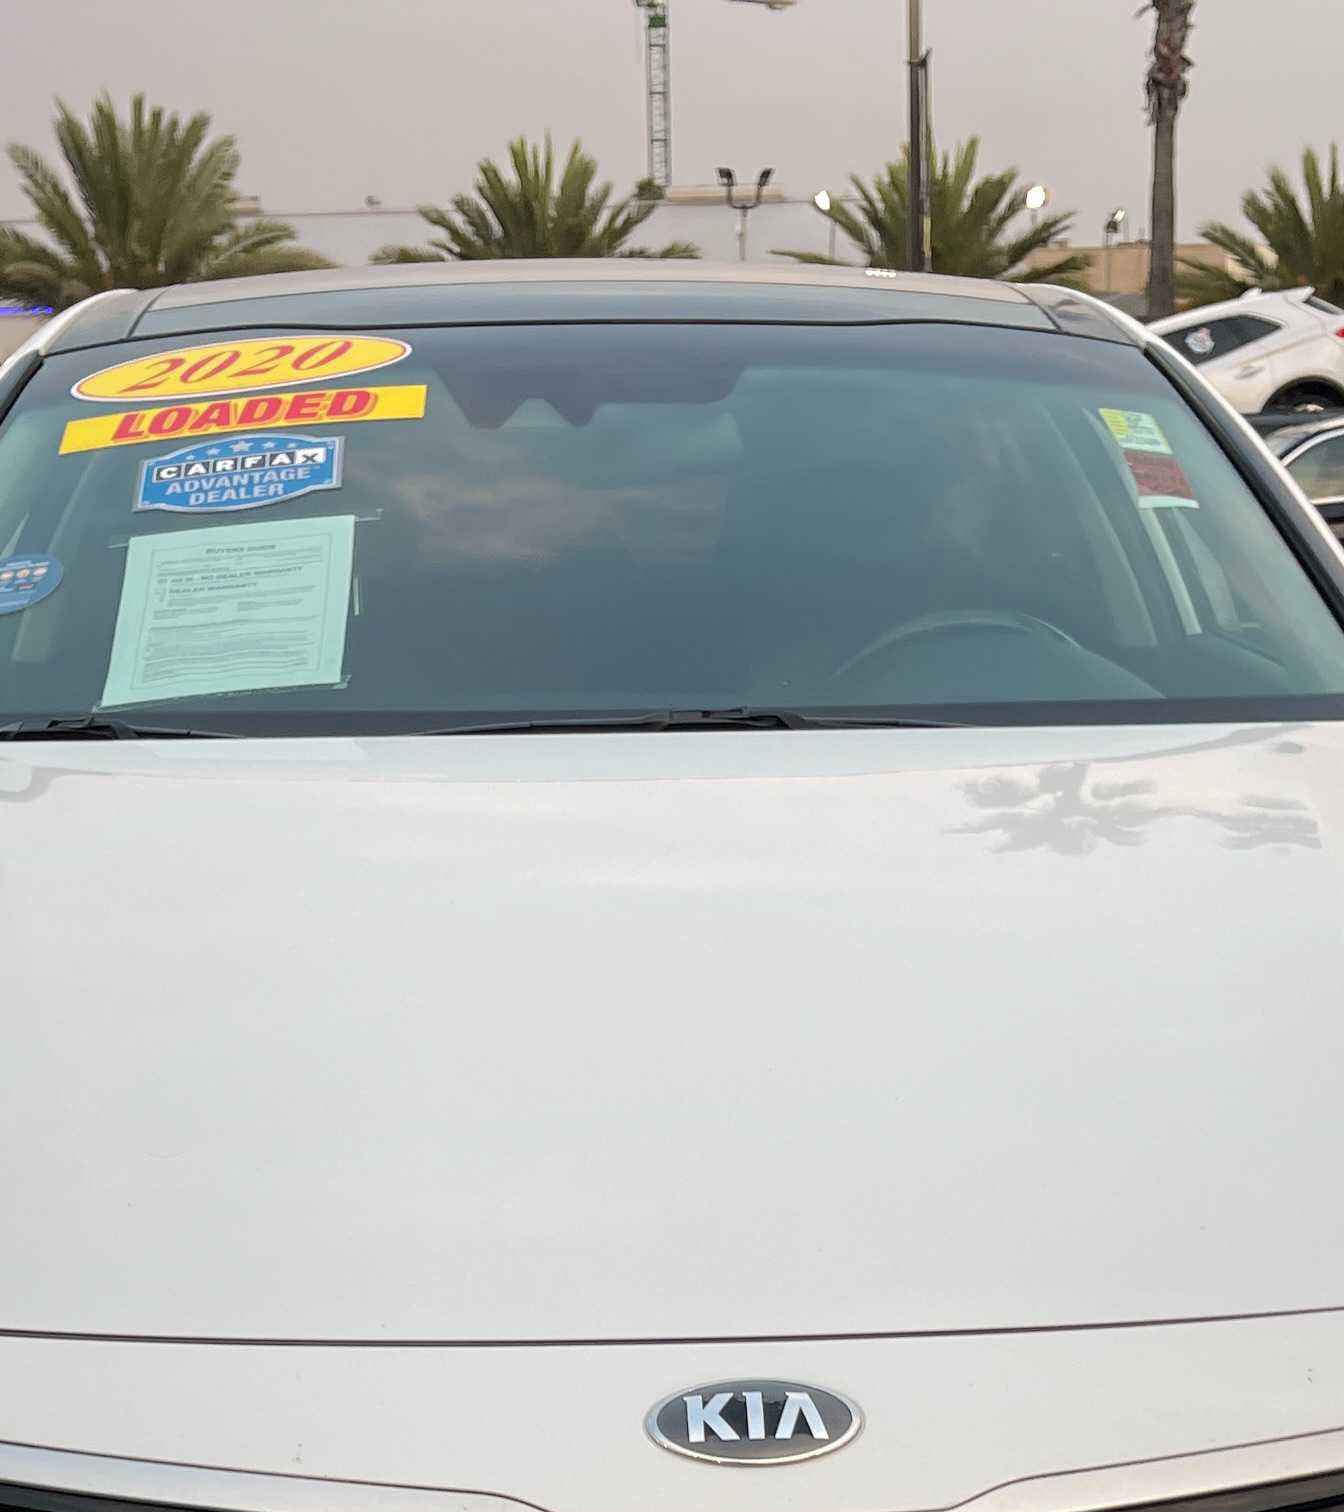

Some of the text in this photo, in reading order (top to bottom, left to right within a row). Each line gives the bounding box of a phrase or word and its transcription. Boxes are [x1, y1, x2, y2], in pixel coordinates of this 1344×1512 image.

[118, 340, 353, 394] 2020
[112, 389, 376, 442] LOADED
[156, 450, 325, 481] CARFAX
[165, 466, 311, 495] ADVANTAGE
[189, 483, 284, 506] DEALER
[683, 1391, 830, 1443] KIA
